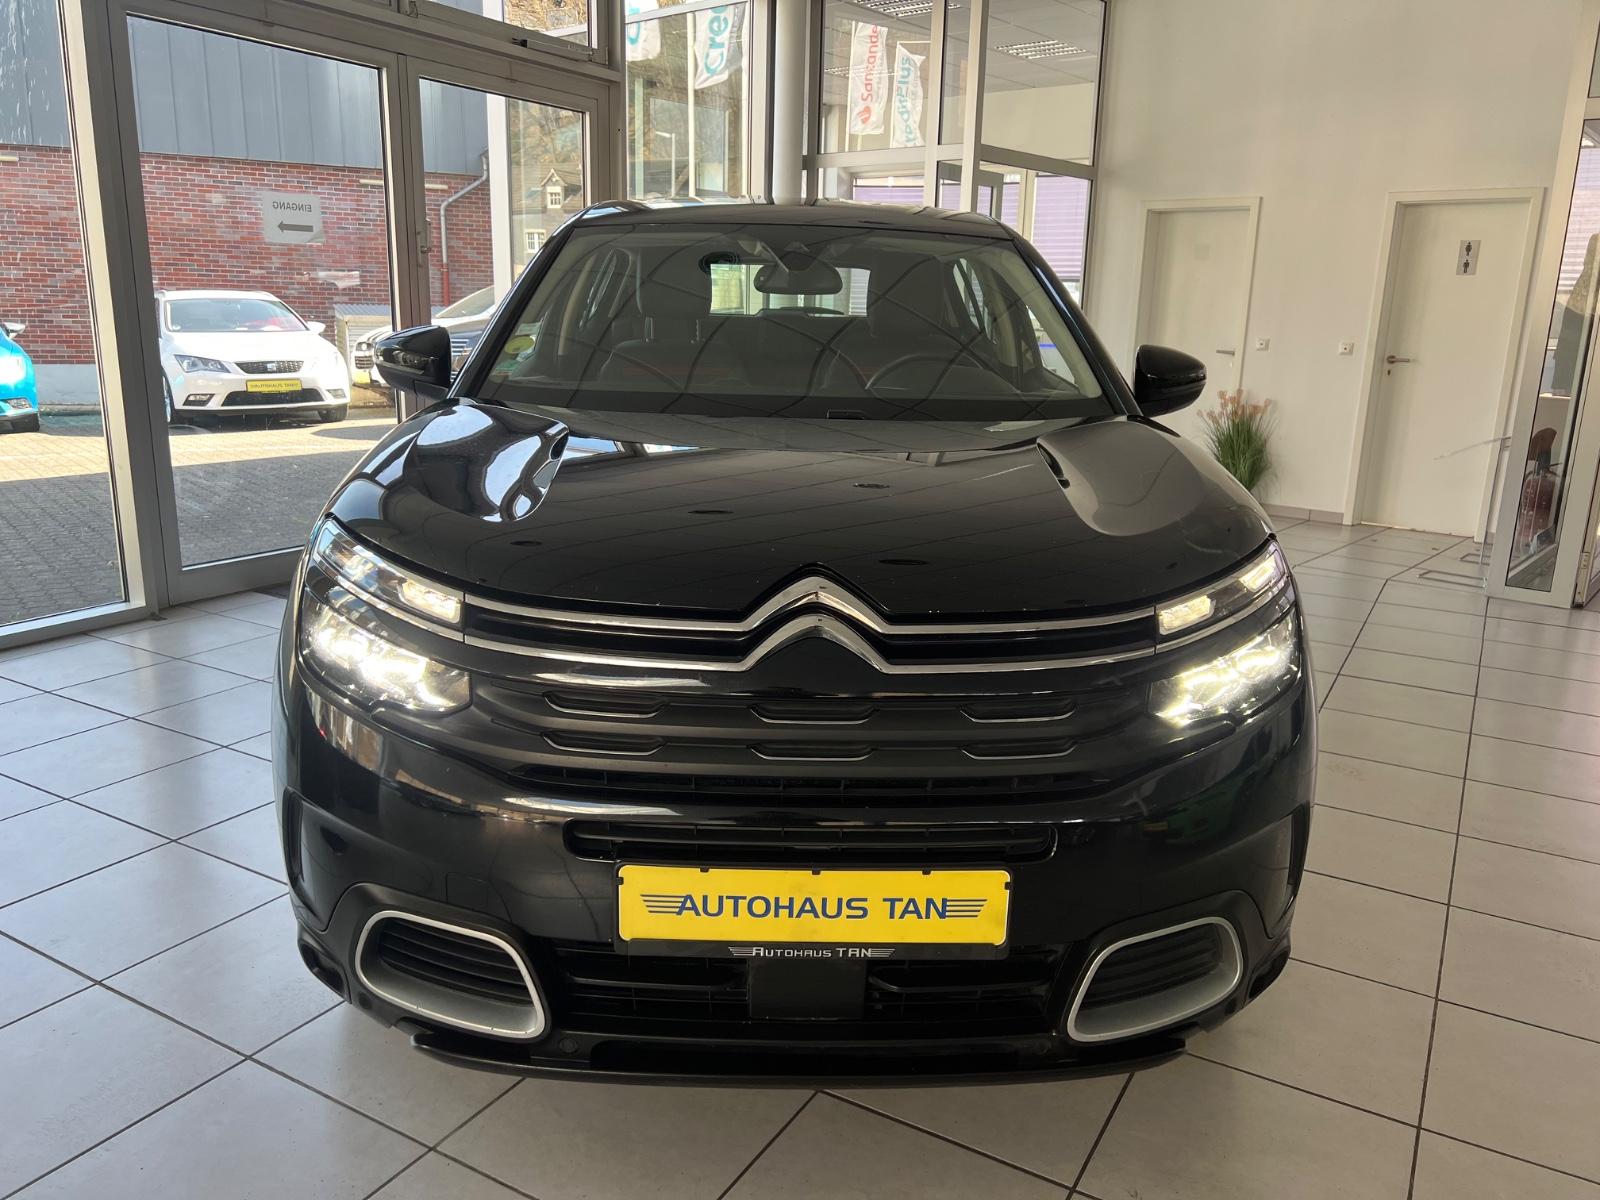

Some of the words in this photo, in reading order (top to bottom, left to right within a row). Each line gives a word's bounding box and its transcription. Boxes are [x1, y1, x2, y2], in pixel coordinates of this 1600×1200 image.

[704, 5, 729, 76] Cre
[676, 894, 868, 919] AUTOHAUS
[882, 897, 947, 919] TAN
[835, 947, 872, 958] TAN
